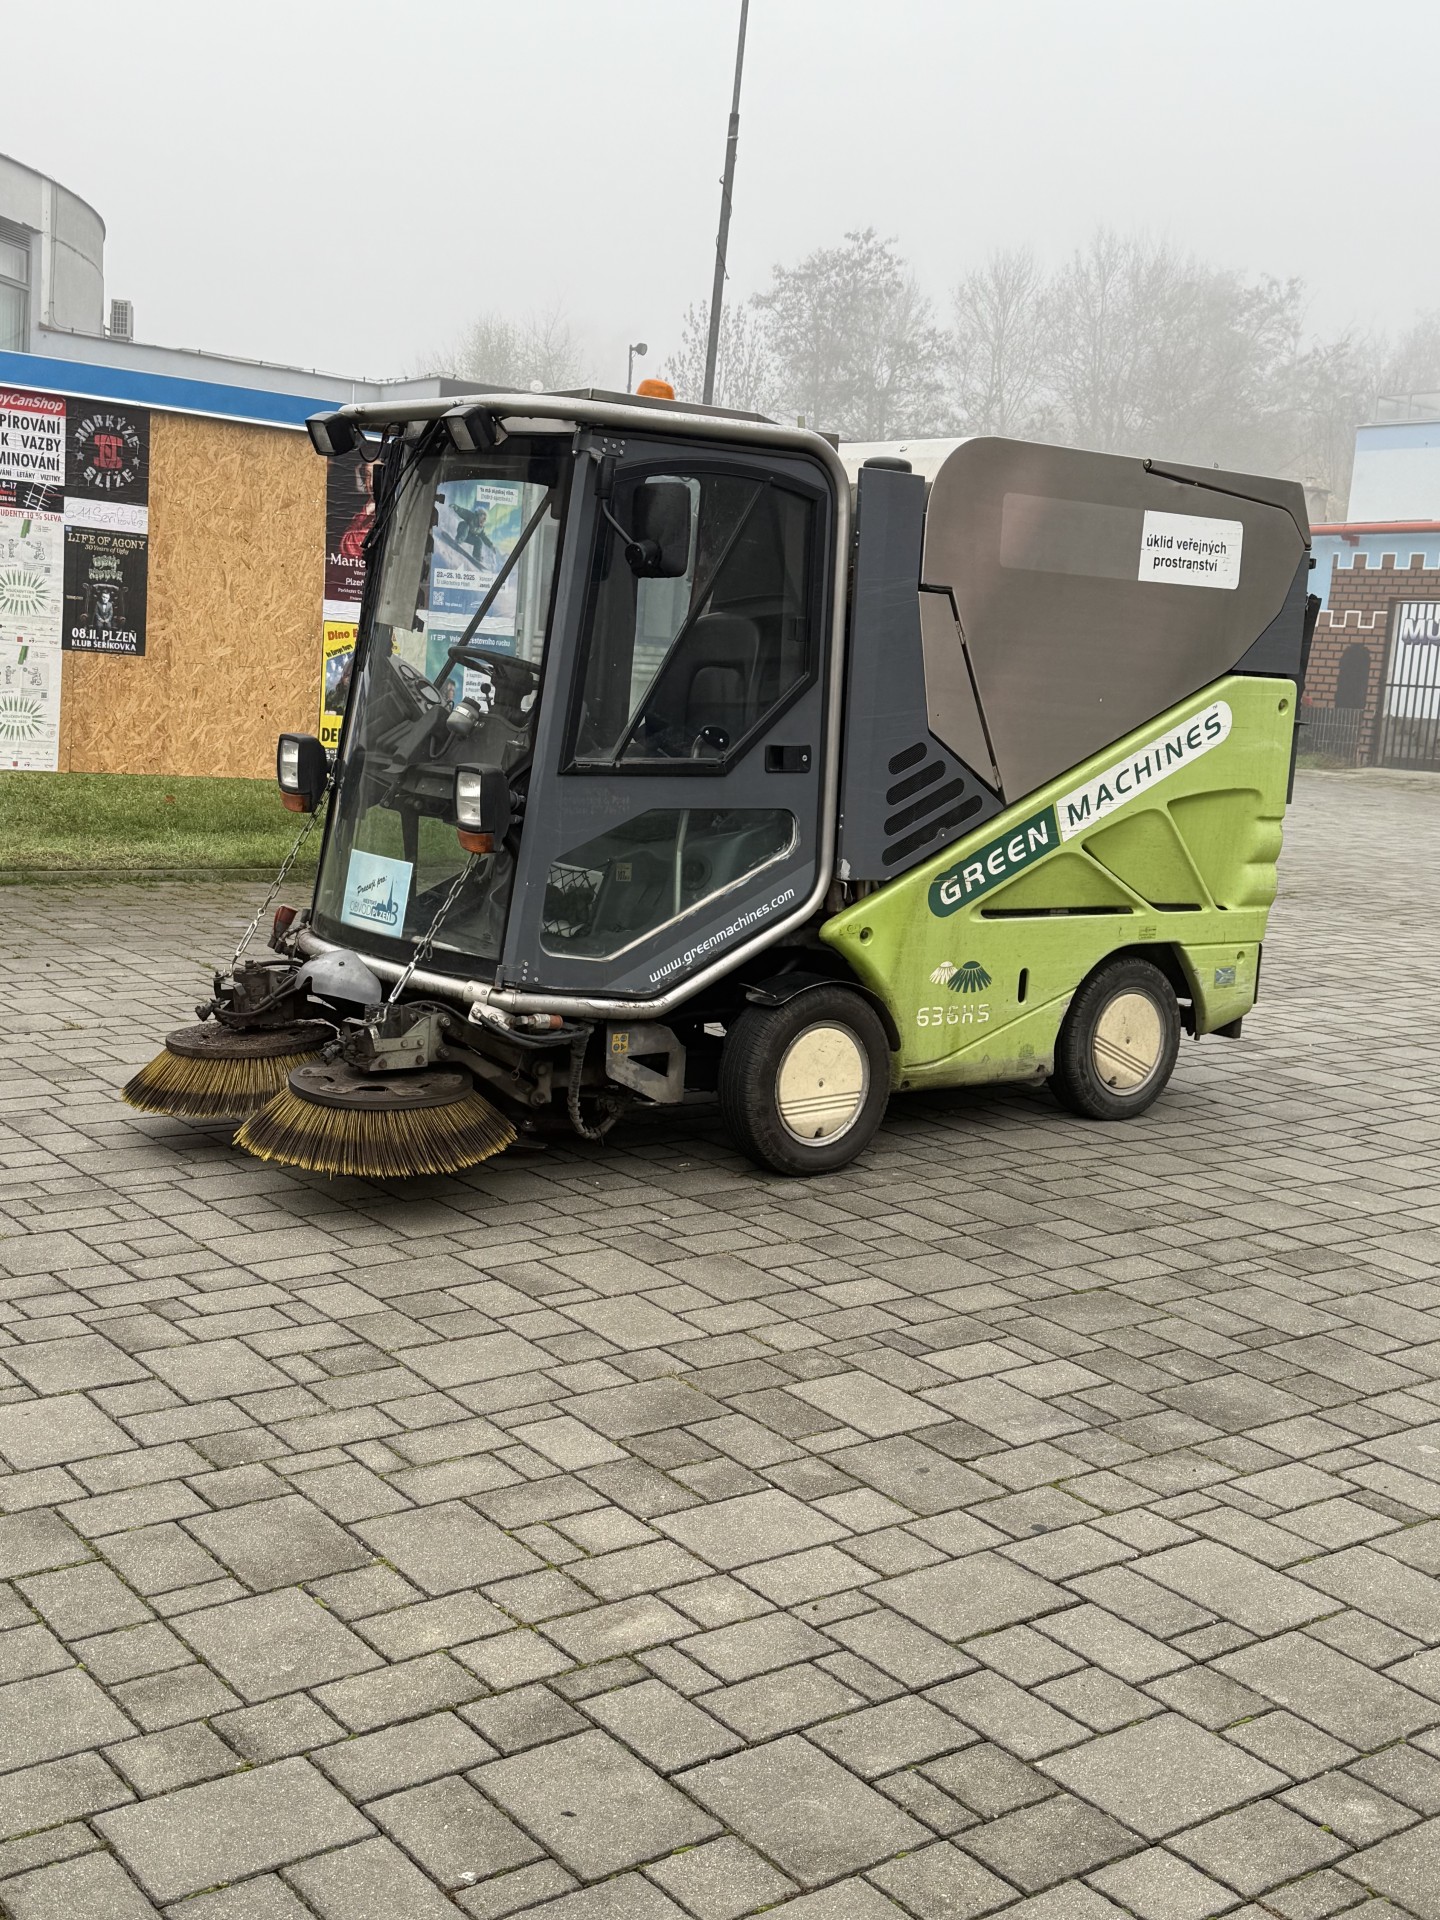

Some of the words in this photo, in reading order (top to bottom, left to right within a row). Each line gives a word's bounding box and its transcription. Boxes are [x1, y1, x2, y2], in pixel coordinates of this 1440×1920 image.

[21, 434, 61, 453] VAZBY
[16, 471, 35, 479] LETÁKY
[44, 514, 62, 522] SLEVA
[67, 532, 96, 544] LIFE
[97, 536, 111, 545] OF
[112, 538, 146, 550] AGONY
[1146, 533, 1173, 549] úklid
[1176, 537, 1227, 556] veřejných
[94, 545, 110, 553] Years
[330, 553, 367, 568] Marie
[1152, 556, 1218, 572] prostranství
[102, 629, 137, 643] PLZEŇ
[327, 630, 350, 641] Dino
[71, 639, 92, 648] KLUB
[939, 820, 1050, 906] GREEN
[1066, 712, 1222, 827] MACHINES
[649, 888, 796, 983] www.greenmachines.com
